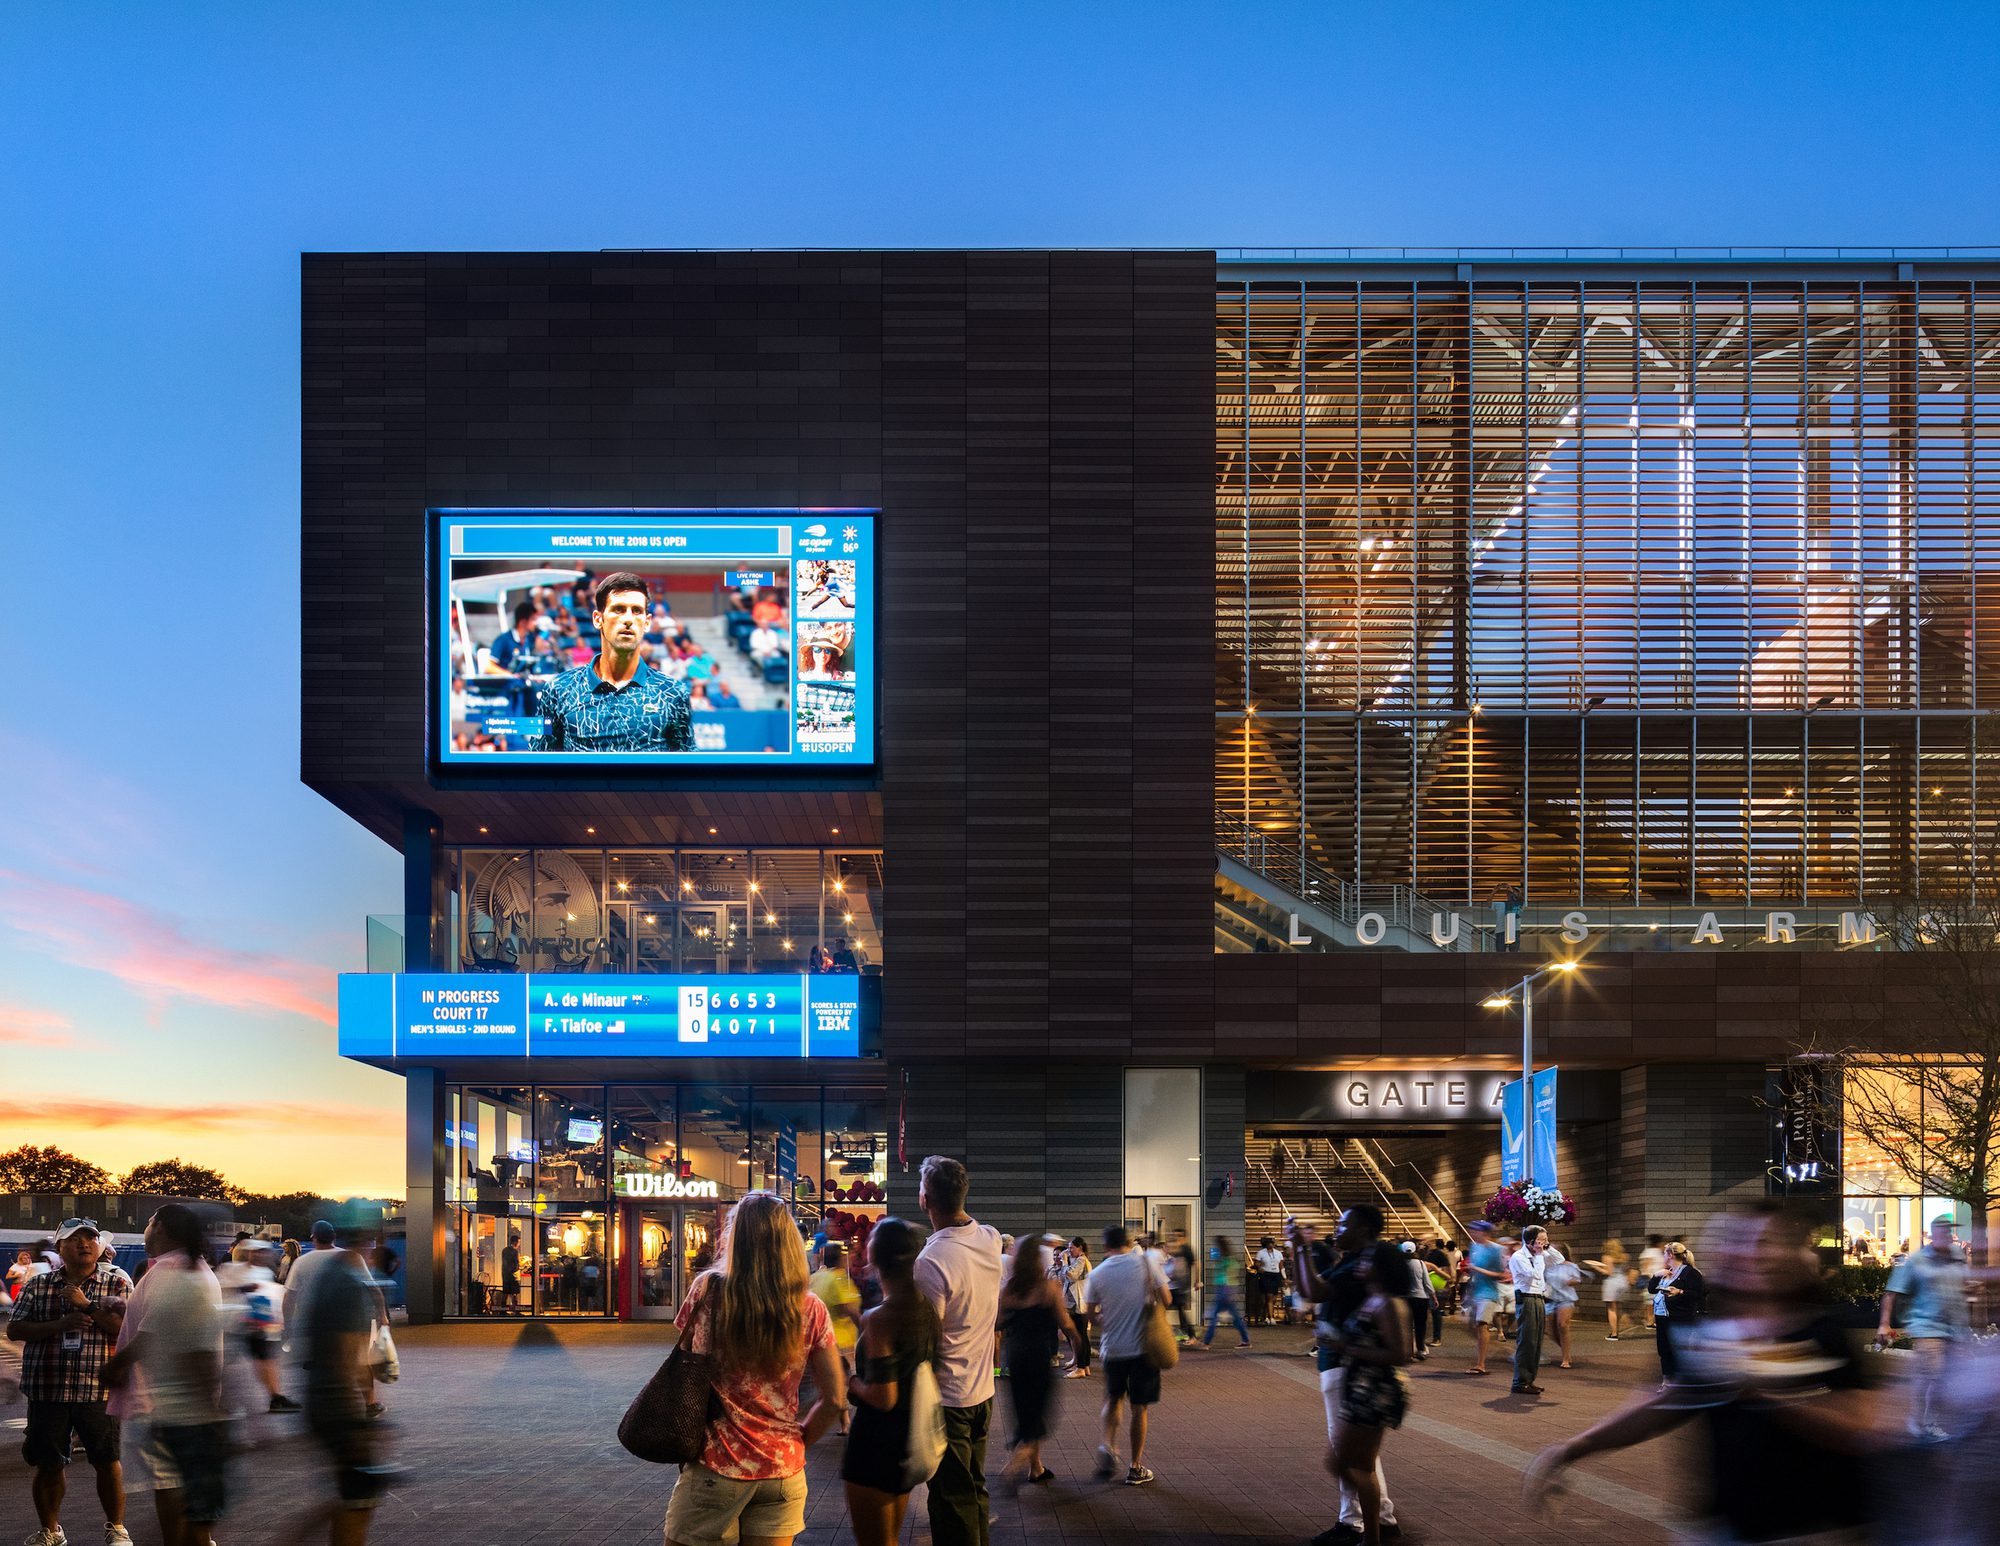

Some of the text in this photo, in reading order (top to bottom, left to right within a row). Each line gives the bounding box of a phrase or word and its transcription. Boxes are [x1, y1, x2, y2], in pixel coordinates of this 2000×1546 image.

[551, 536, 687, 546] WELCOME TO THE 2018 US OPEN
[801, 743, 853, 753] #USOPEN
[1289, 912, 1590, 946] LOUIS
[422, 990, 500, 1003] IN PROGRESS
[544, 992, 776, 1008] A. de Minaur 15 6 6 5 3
[433, 1007, 488, 1020] COURT 17
[410, 1025, 434, 1034] MEN'S
[435, 1025, 467, 1034] SINGLES
[473, 1025, 488, 1034] 2ND
[490, 1025, 516, 1034] ROUND
[545, 1018, 775, 1034] F. Tiafoe 0 4 0 7 1
[818, 1016, 850, 1031] IBM
[1345, 1080, 1467, 1107] GATE
[1793, 1091, 1805, 1141] POLO
[625, 1173, 719, 1198] Wilson
